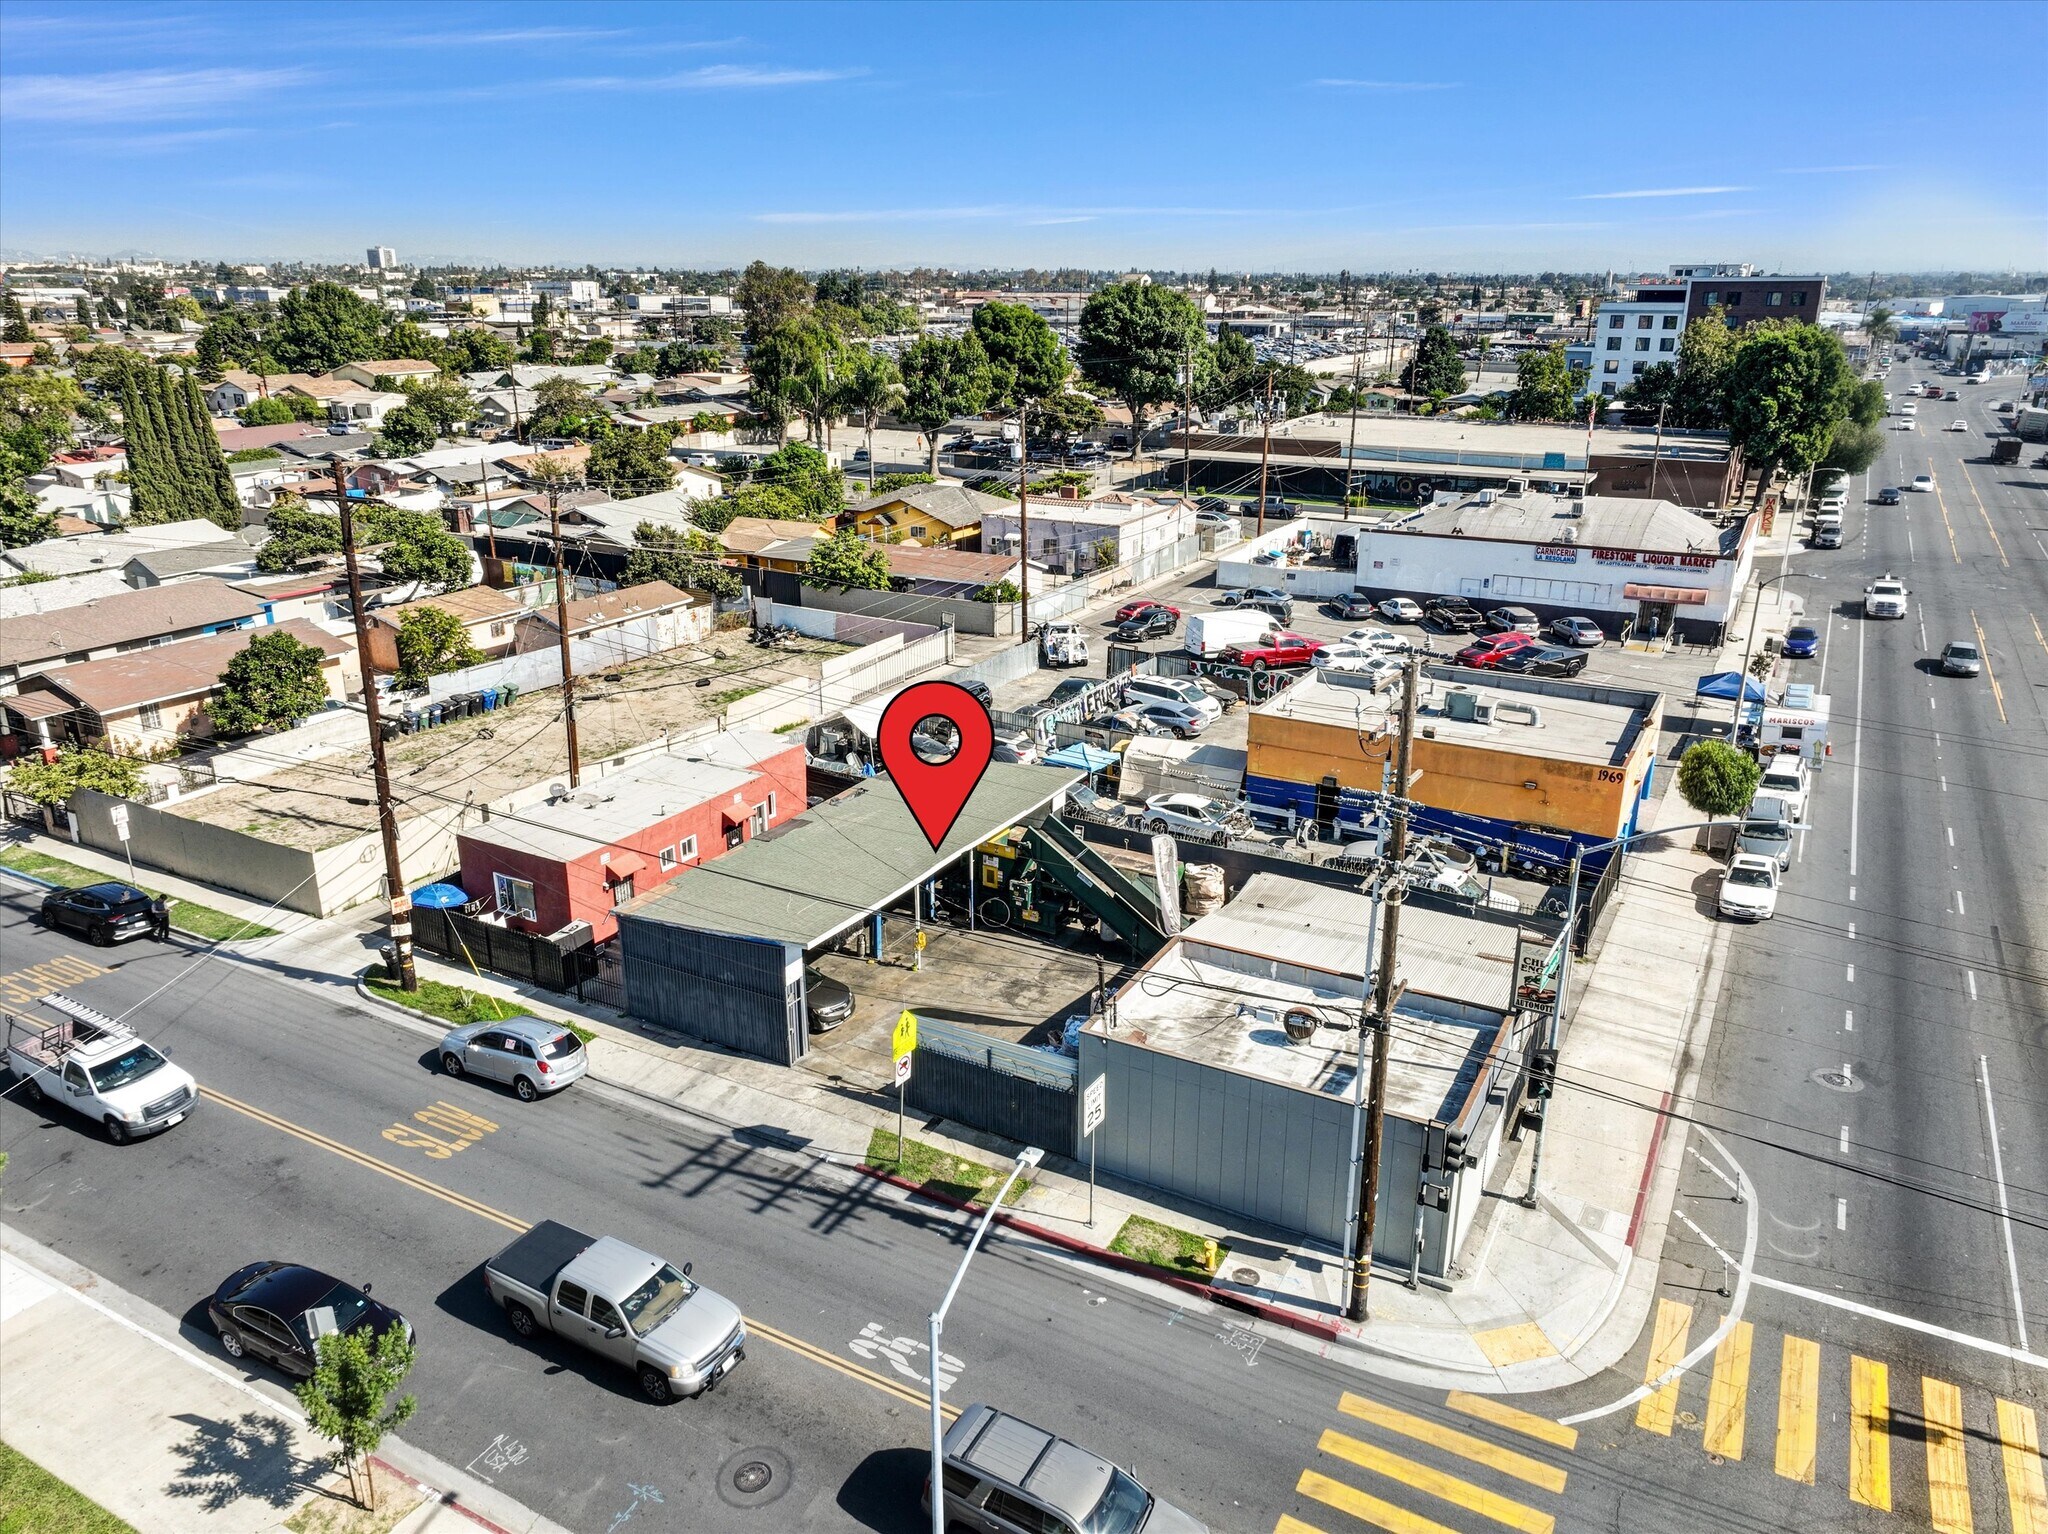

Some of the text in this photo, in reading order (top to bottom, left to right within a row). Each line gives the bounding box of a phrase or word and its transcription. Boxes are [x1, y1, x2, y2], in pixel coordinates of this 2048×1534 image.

[1762, 498, 1776, 535] MARKET
[1535, 546, 1576, 557] CARNICERIA
[1591, 549, 1718, 569] FIRESTONE LIQUOR MARKET
[1768, 716, 1816, 726] MARISCOS
[1597, 769, 1624, 784] 1969
[1086, 1081, 1104, 1100] SPEED
[1087, 1093, 1102, 1109] LIMIT
[1087, 1104, 1102, 1129] 25
[381, 1100, 500, 1159] SLOW
